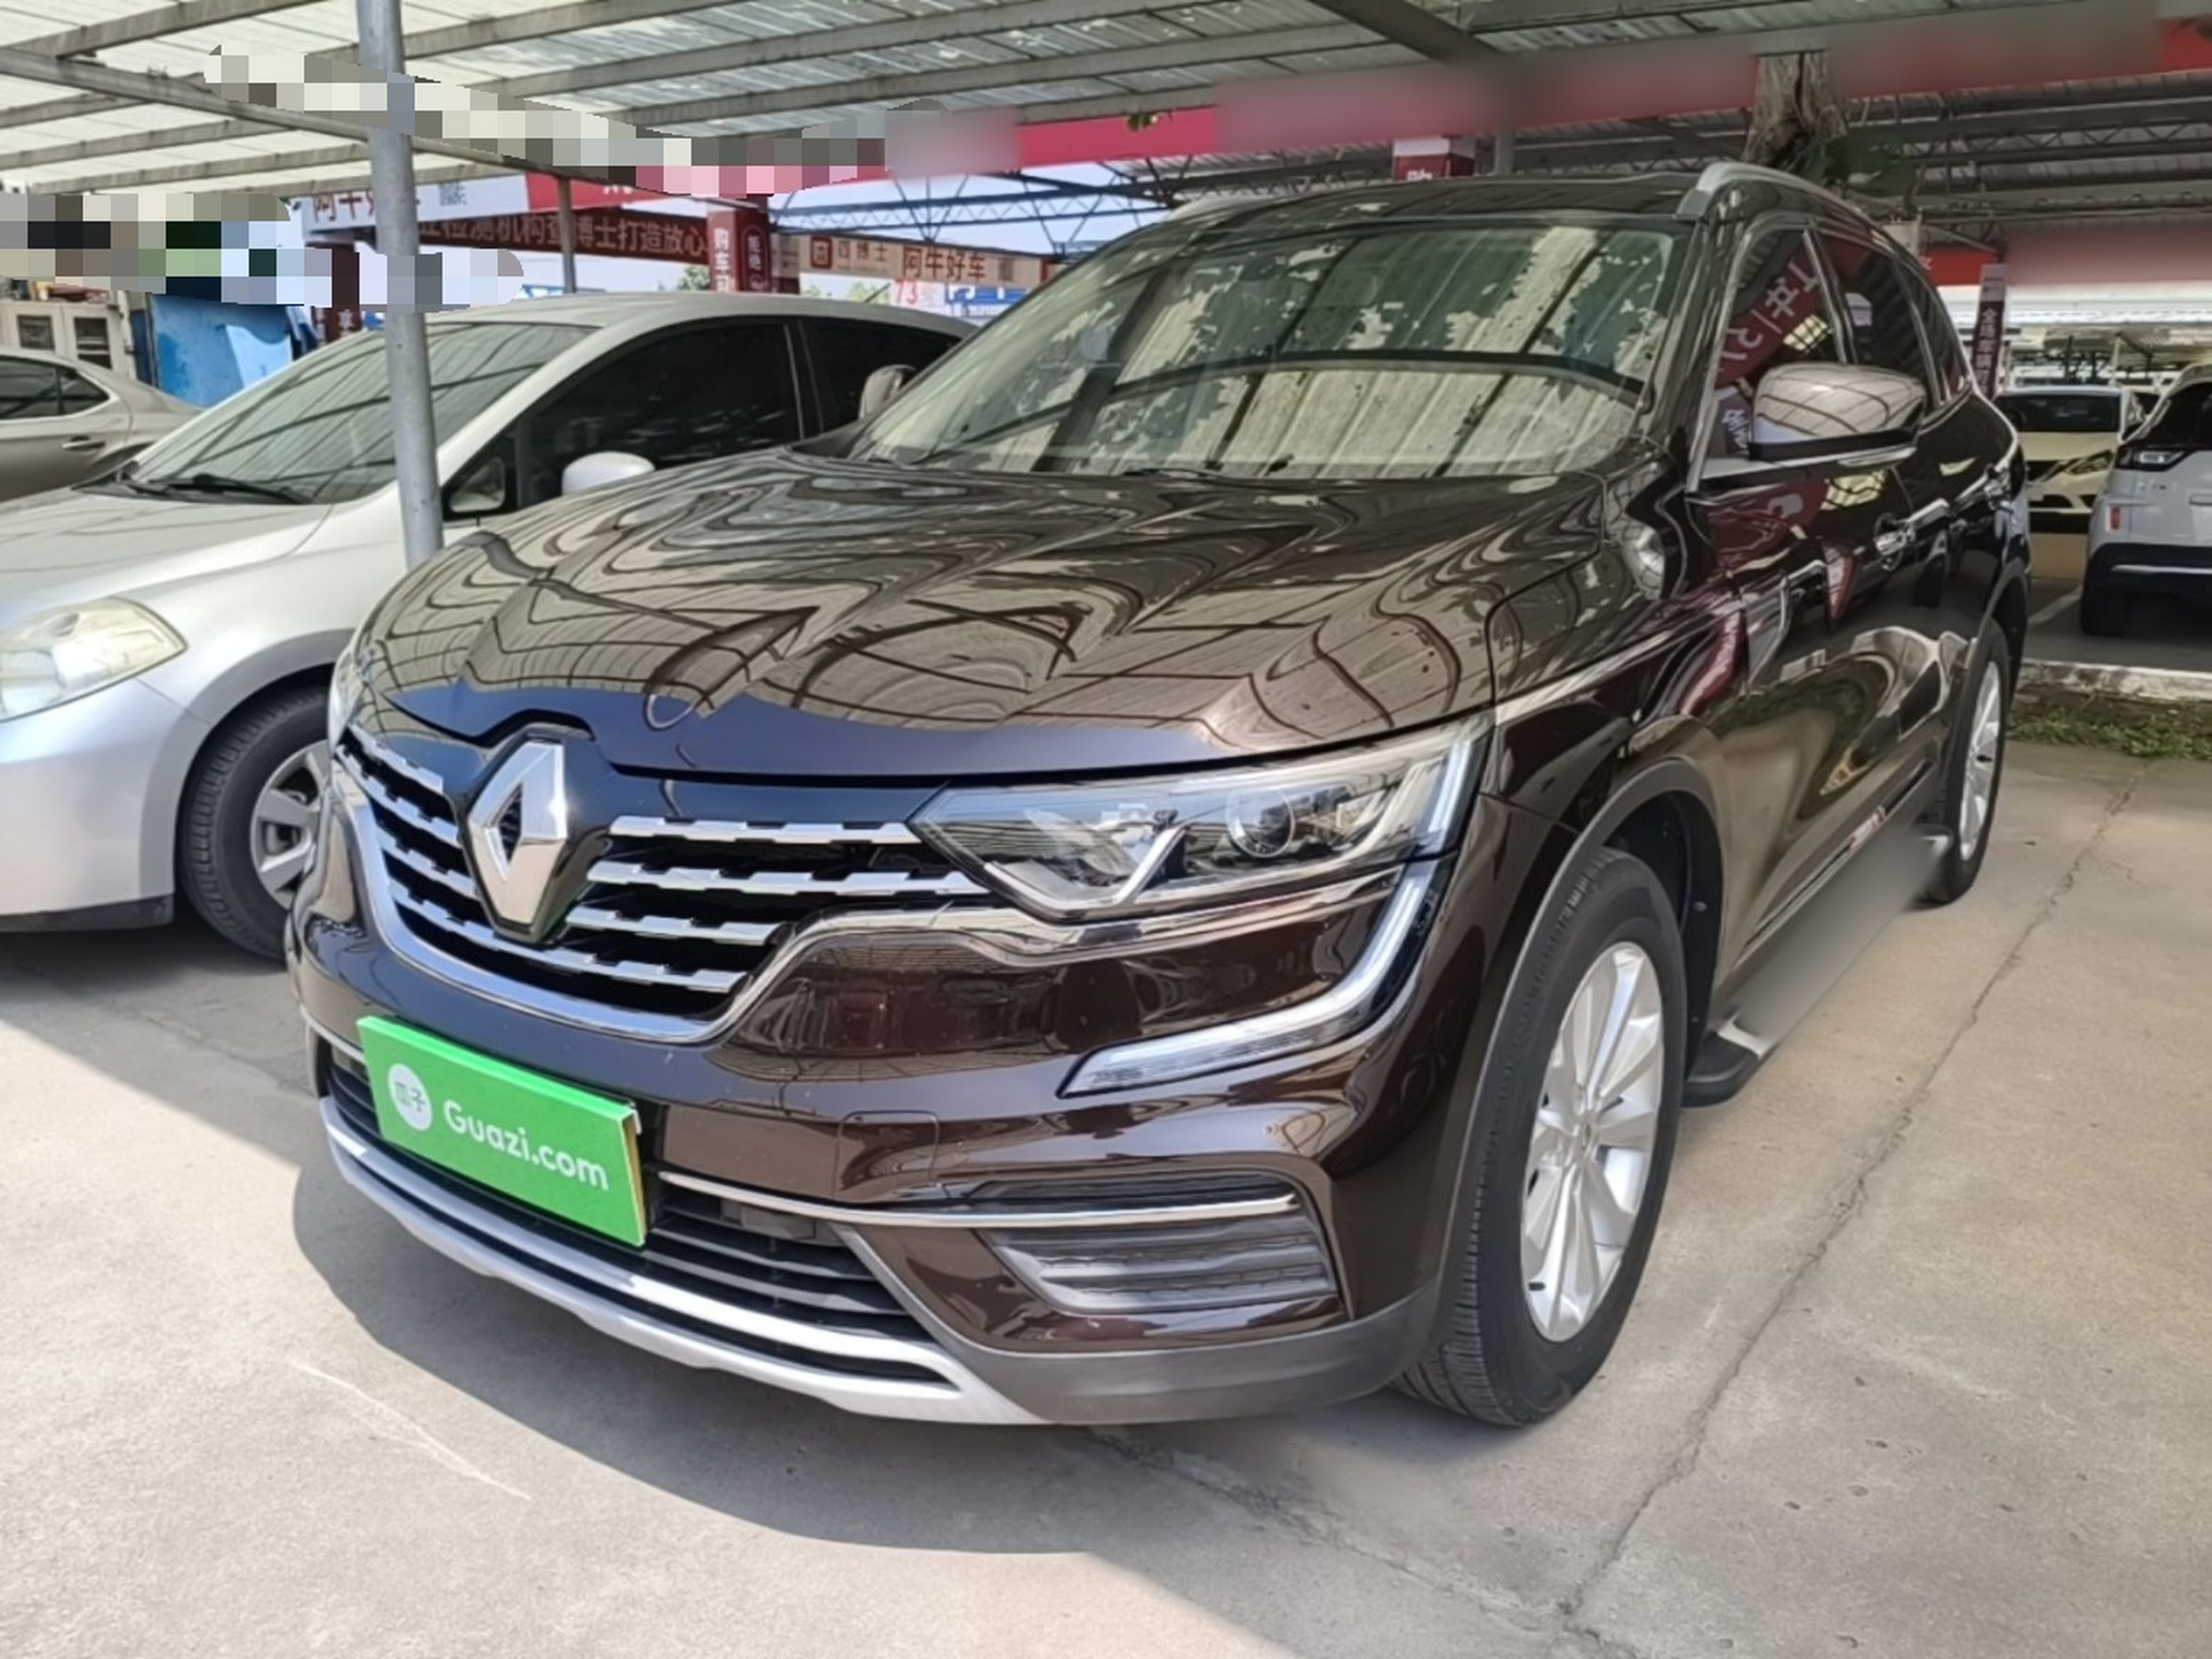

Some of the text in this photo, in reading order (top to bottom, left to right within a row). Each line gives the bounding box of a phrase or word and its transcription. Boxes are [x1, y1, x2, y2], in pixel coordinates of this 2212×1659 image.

[903, 245, 986, 282] 阿牛好车
[442, 1099, 609, 1191] Guazi.com
